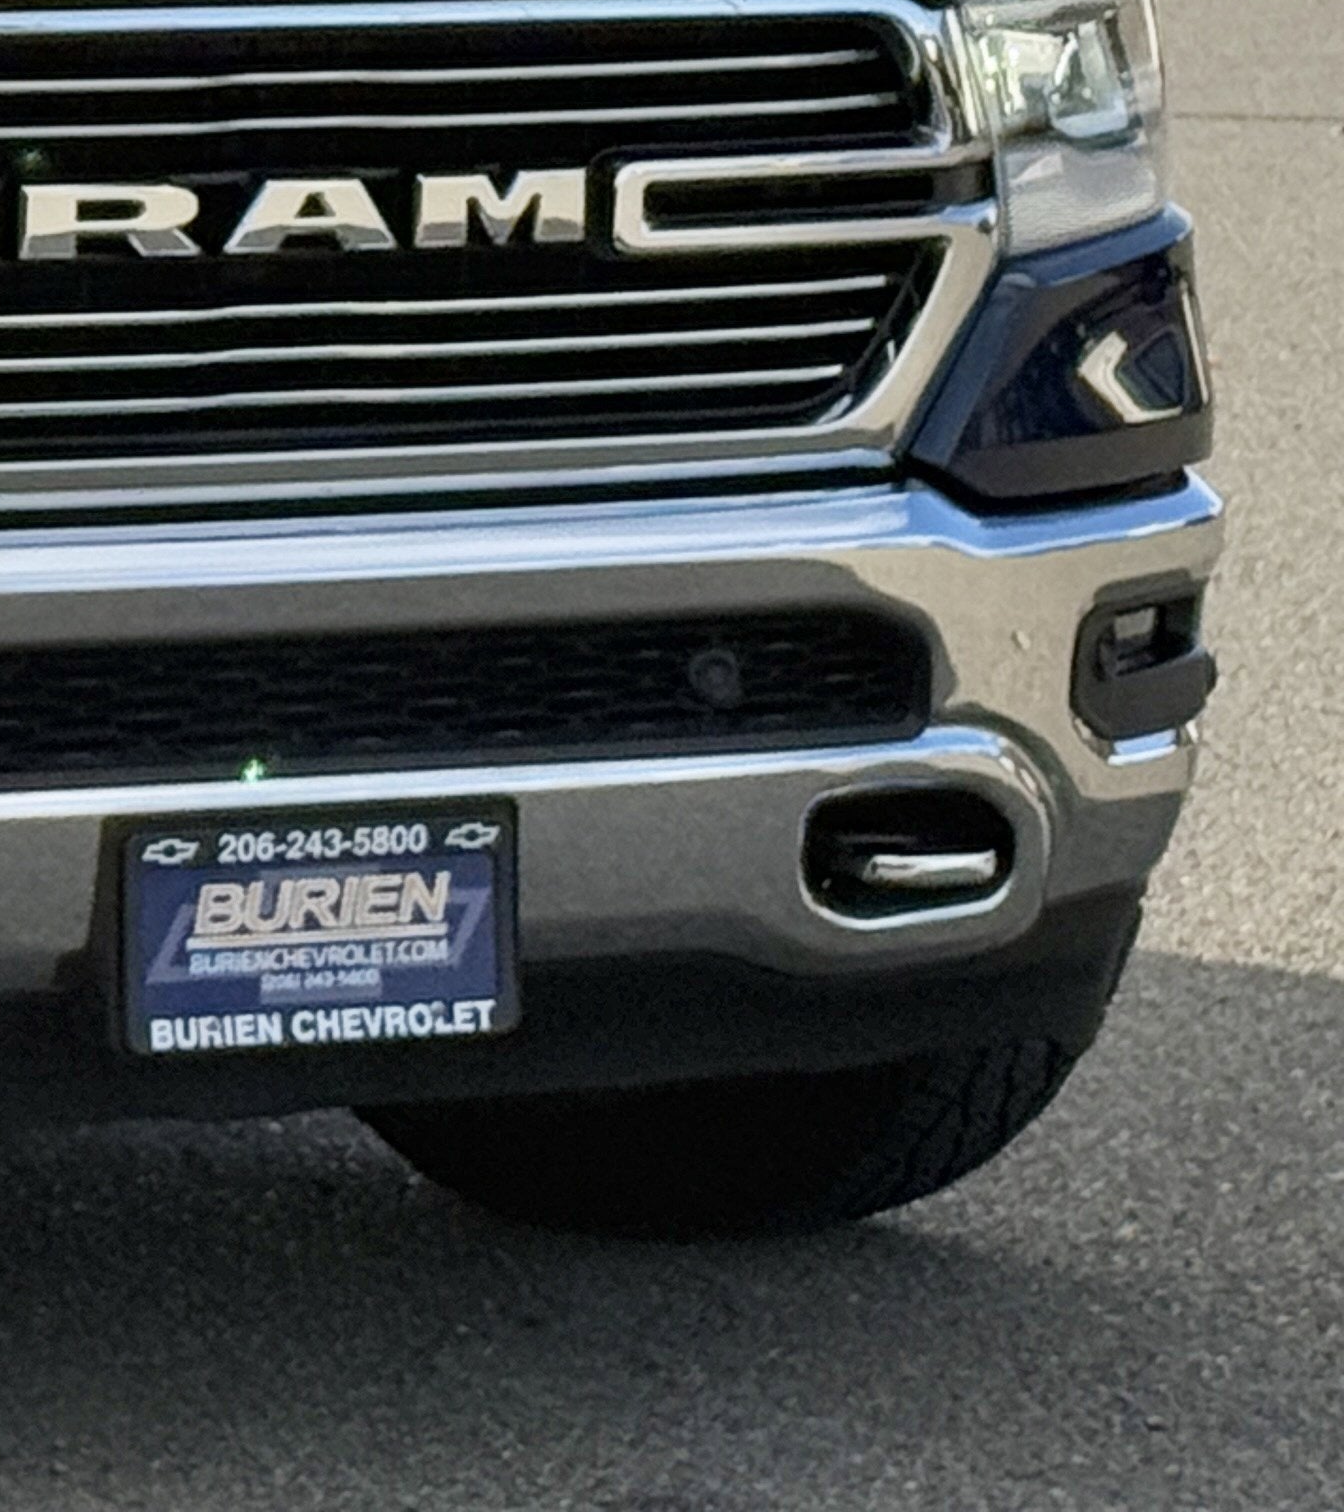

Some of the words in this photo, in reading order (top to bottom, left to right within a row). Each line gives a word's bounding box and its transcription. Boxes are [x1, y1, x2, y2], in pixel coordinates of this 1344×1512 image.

[18, 168, 586, 260] RAM
[218, 824, 429, 864] 206-243-5800
[195, 871, 451, 933] BURIEN
[150, 1013, 283, 1052] BURIEN
[290, 1000, 496, 1040] CHEVROLET
